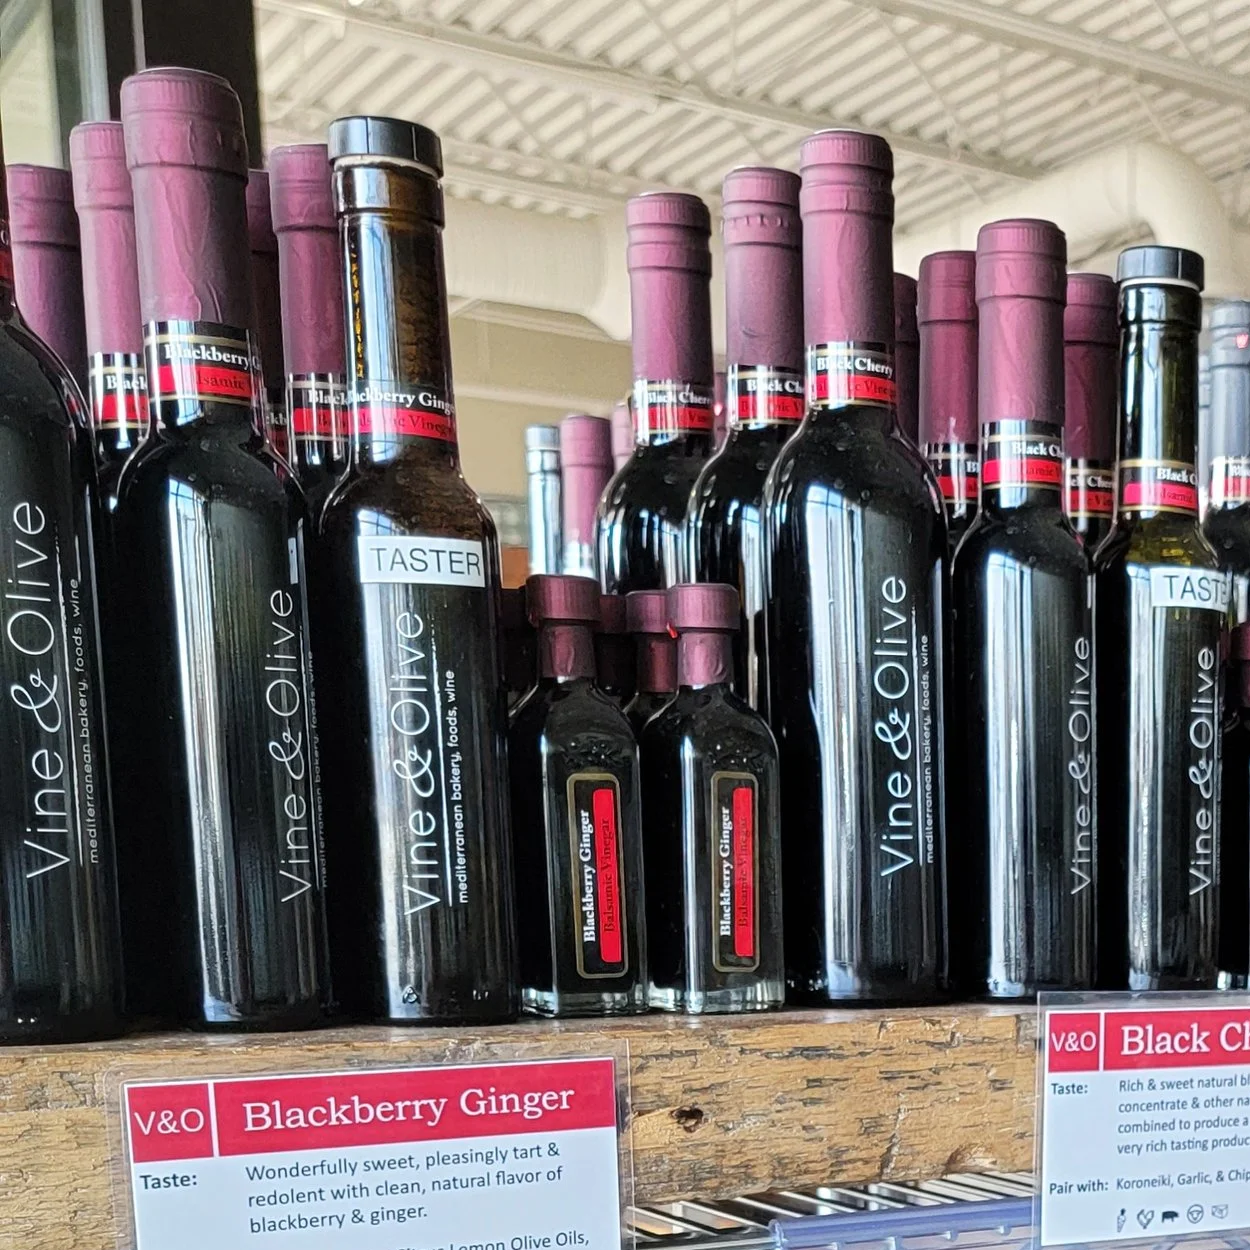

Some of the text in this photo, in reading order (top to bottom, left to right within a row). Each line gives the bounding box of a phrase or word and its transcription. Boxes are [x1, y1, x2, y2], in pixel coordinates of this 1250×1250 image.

[369, 547, 481, 577] TASTER
[5, 501, 71, 878] Vine & Olive
[71, 578, 99, 863] mediterranean bakery, foods, wine
[874, 576, 914, 876] Vine & Olive
[390, 612, 440, 915] Vine & Olive
[445, 671, 469, 903] mediterranean bakery, foods, wine
[579, 809, 597, 943] Blackberry Ginger
[1051, 1030, 1096, 1052] V&O
[1120, 1022, 1210, 1055] Black
[1050, 1082, 1088, 1095] Taste:
[1119, 1079, 1144, 1092] Rich
[1147, 1078, 1156, 1091] &
[1160, 1078, 1194, 1090] sweet
[1197, 1074, 1237, 1088] natural
[242, 1087, 574, 1131] Blackberry Ginger
[1118, 1099, 1188, 1113] concentrate
[1190, 1096, 1200, 1109] &
[1203, 1095, 1234, 1108] other
[133, 1108, 204, 1135] V&O
[1117, 1118, 1176, 1134] combined
[1178, 1119, 1191, 1130] to
[1193, 1115, 1240, 1131] produce
[1242, 1116, 1249, 1126] a
[1117, 1143, 1143, 1156] very
[1145, 1139, 1167, 1152] rich
[1170, 1137, 1208, 1151] tasting
[245, 1142, 560, 1181] Wonderfully sweet, pleasingly tart &
[139, 1173, 197, 1189] Taste:
[248, 1165, 562, 1207] redolent with clean, natural flavor of
[1049, 1179, 1108, 1195] Pair with:
[1116, 1174, 1174, 1190] Koroneiki,
[1177, 1171, 1212, 1185] Garlic,
[1215, 1170, 1224, 1182] &
[250, 1206, 427, 1233] blackberry & ginger.
[510, 1235, 551, 1250] Olive
[555, 1230, 589, 1246] Oils,
